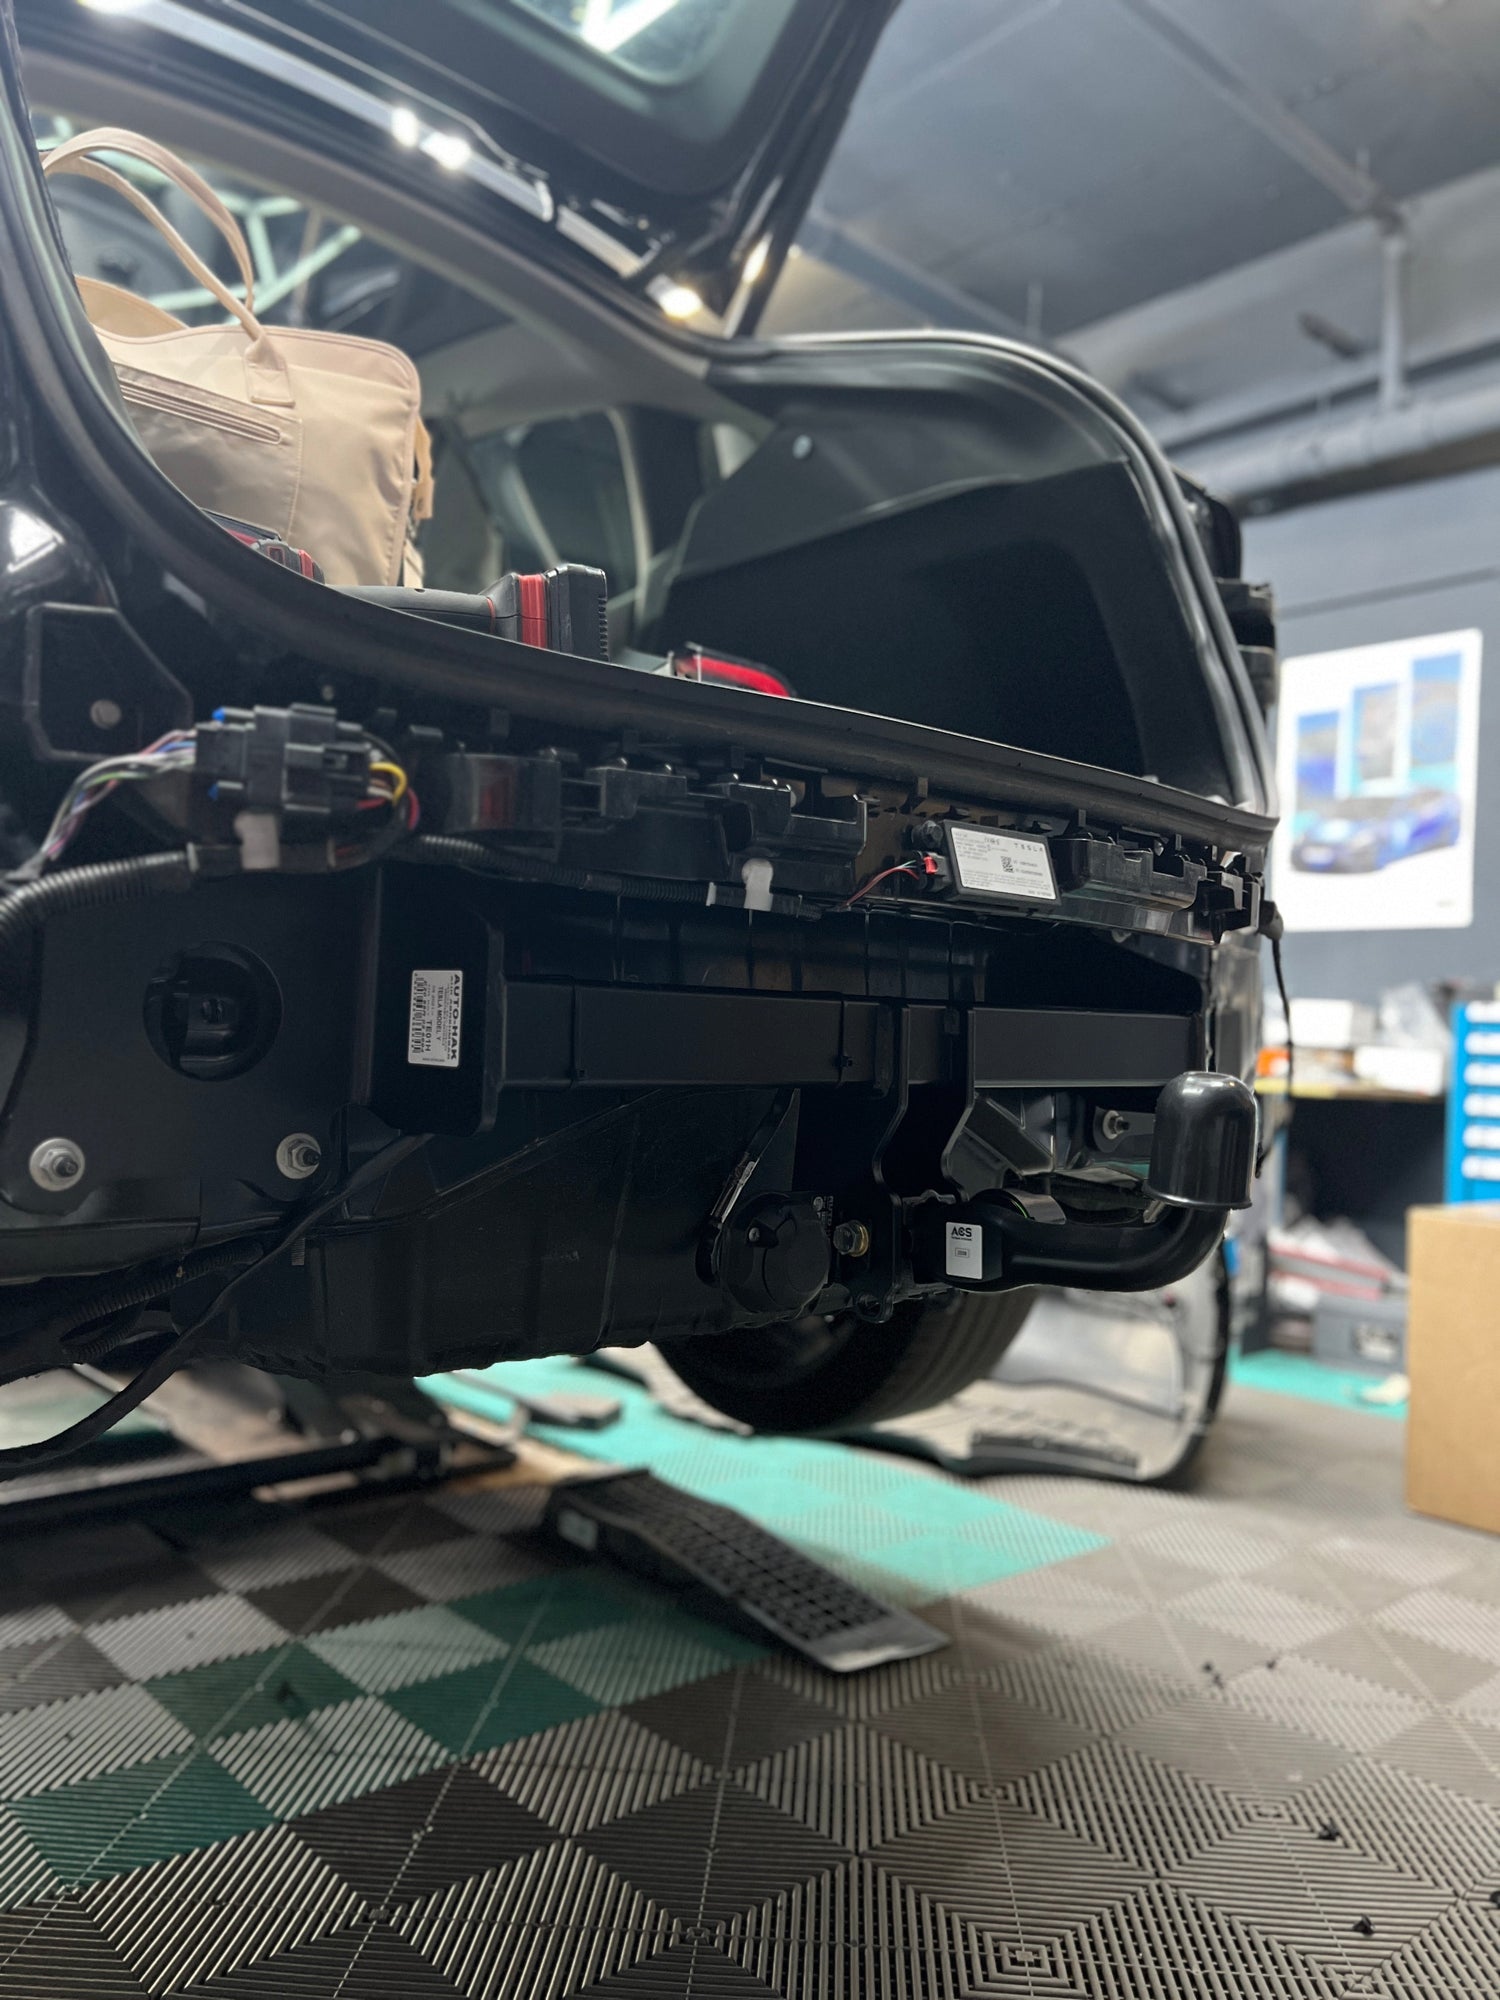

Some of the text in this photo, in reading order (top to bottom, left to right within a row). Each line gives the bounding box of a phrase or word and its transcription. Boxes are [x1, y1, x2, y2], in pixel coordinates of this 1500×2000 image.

[1014, 842, 1043, 852] TESLA
[451, 974, 460, 1060] AUTO-HAK
[951, 1226, 972, 1237] ACS
